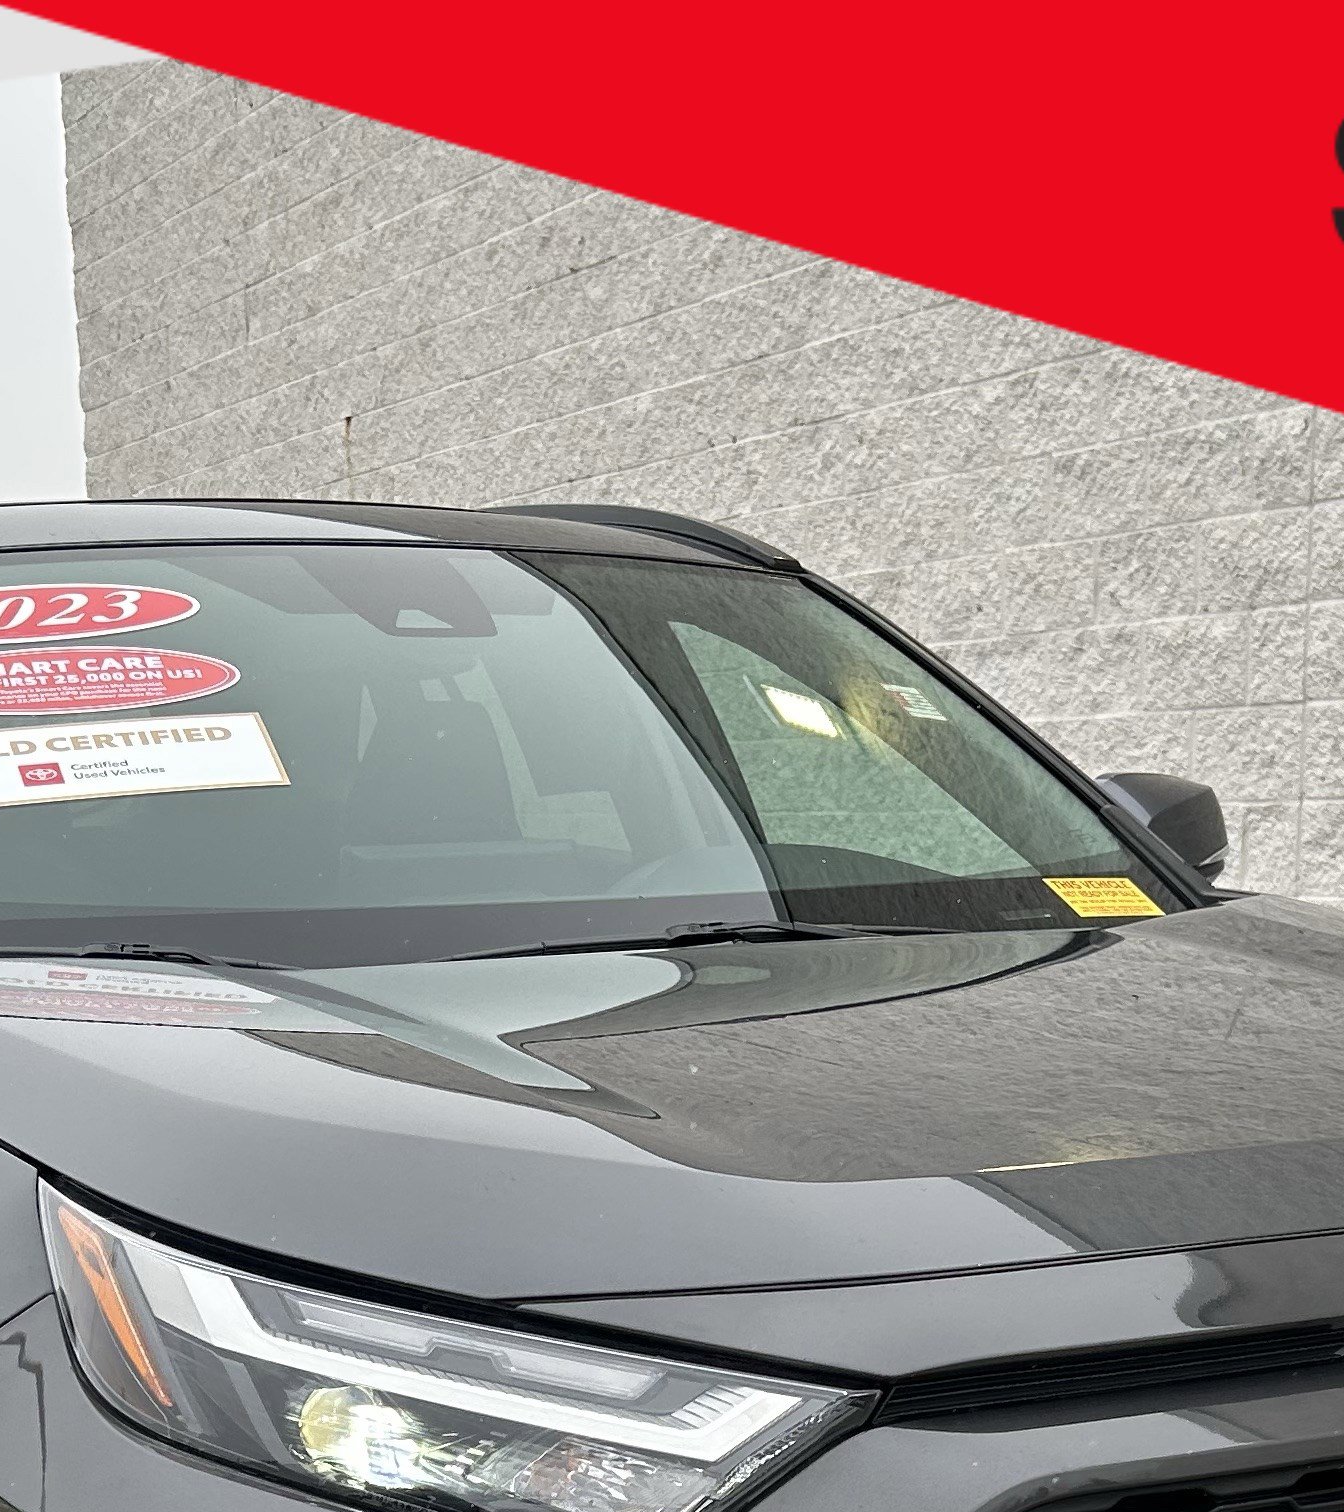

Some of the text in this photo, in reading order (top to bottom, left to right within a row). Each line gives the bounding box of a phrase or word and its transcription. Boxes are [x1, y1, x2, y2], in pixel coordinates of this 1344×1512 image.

[77, 656, 165, 674] CARE
[129, 669, 164, 681] ON
[45, 726, 233, 753] CERTIFIED
[70, 759, 129, 772] Certified
[73, 765, 166, 780] Used Vehicles
[1050, 880, 1082, 889] THIS
